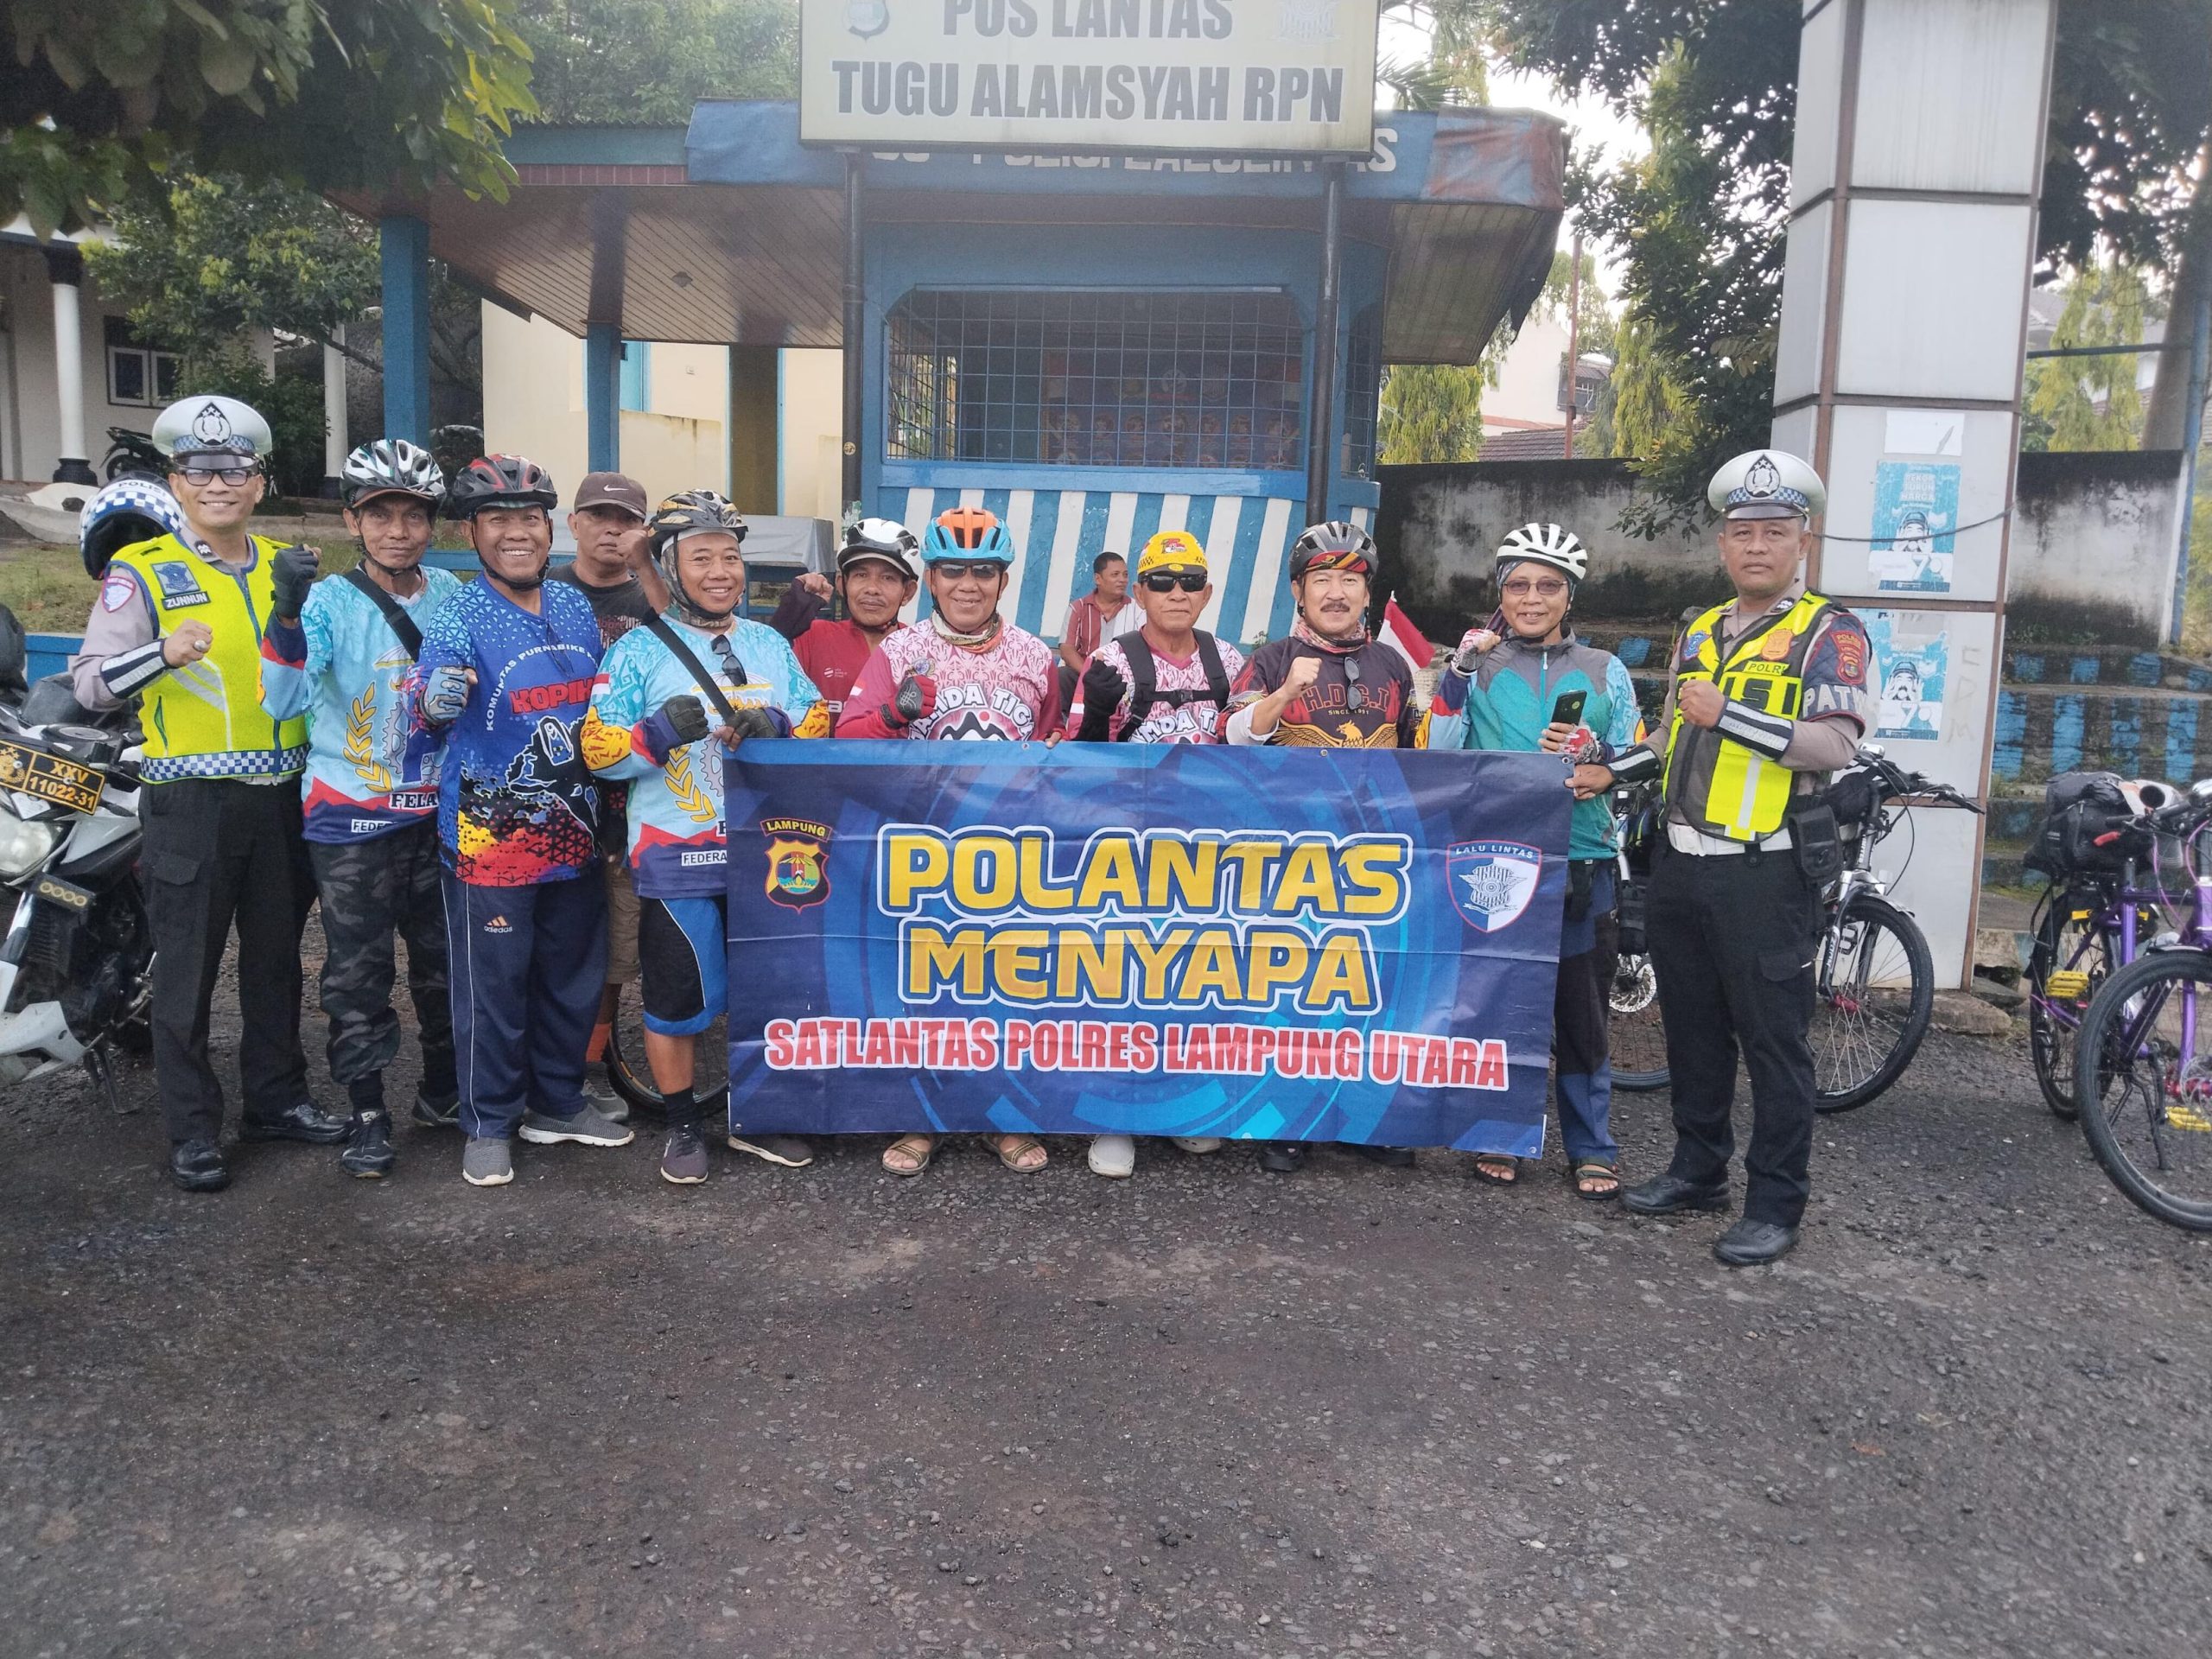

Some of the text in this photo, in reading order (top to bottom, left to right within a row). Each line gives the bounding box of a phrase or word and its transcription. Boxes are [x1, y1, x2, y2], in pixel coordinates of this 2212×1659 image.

[943, 0, 1233, 40] POS LANTAS
[832, 60, 1344, 123] TUGU ALAMSYAH RPN
[165, 593, 207, 608] ZUNNUN
[50, 761, 89, 784] XXV
[29, 776, 95, 810] 11022-31
[766, 821, 827, 837] LAMPUNG
[1455, 845, 1535, 859] LALU LINTAS
[883, 833, 1407, 918] POLANTAS
[907, 925, 1374, 1007] MENYAPA
[766, 1018, 1507, 1090] SATLANTAS POLRES LAMPUNG UTARA
